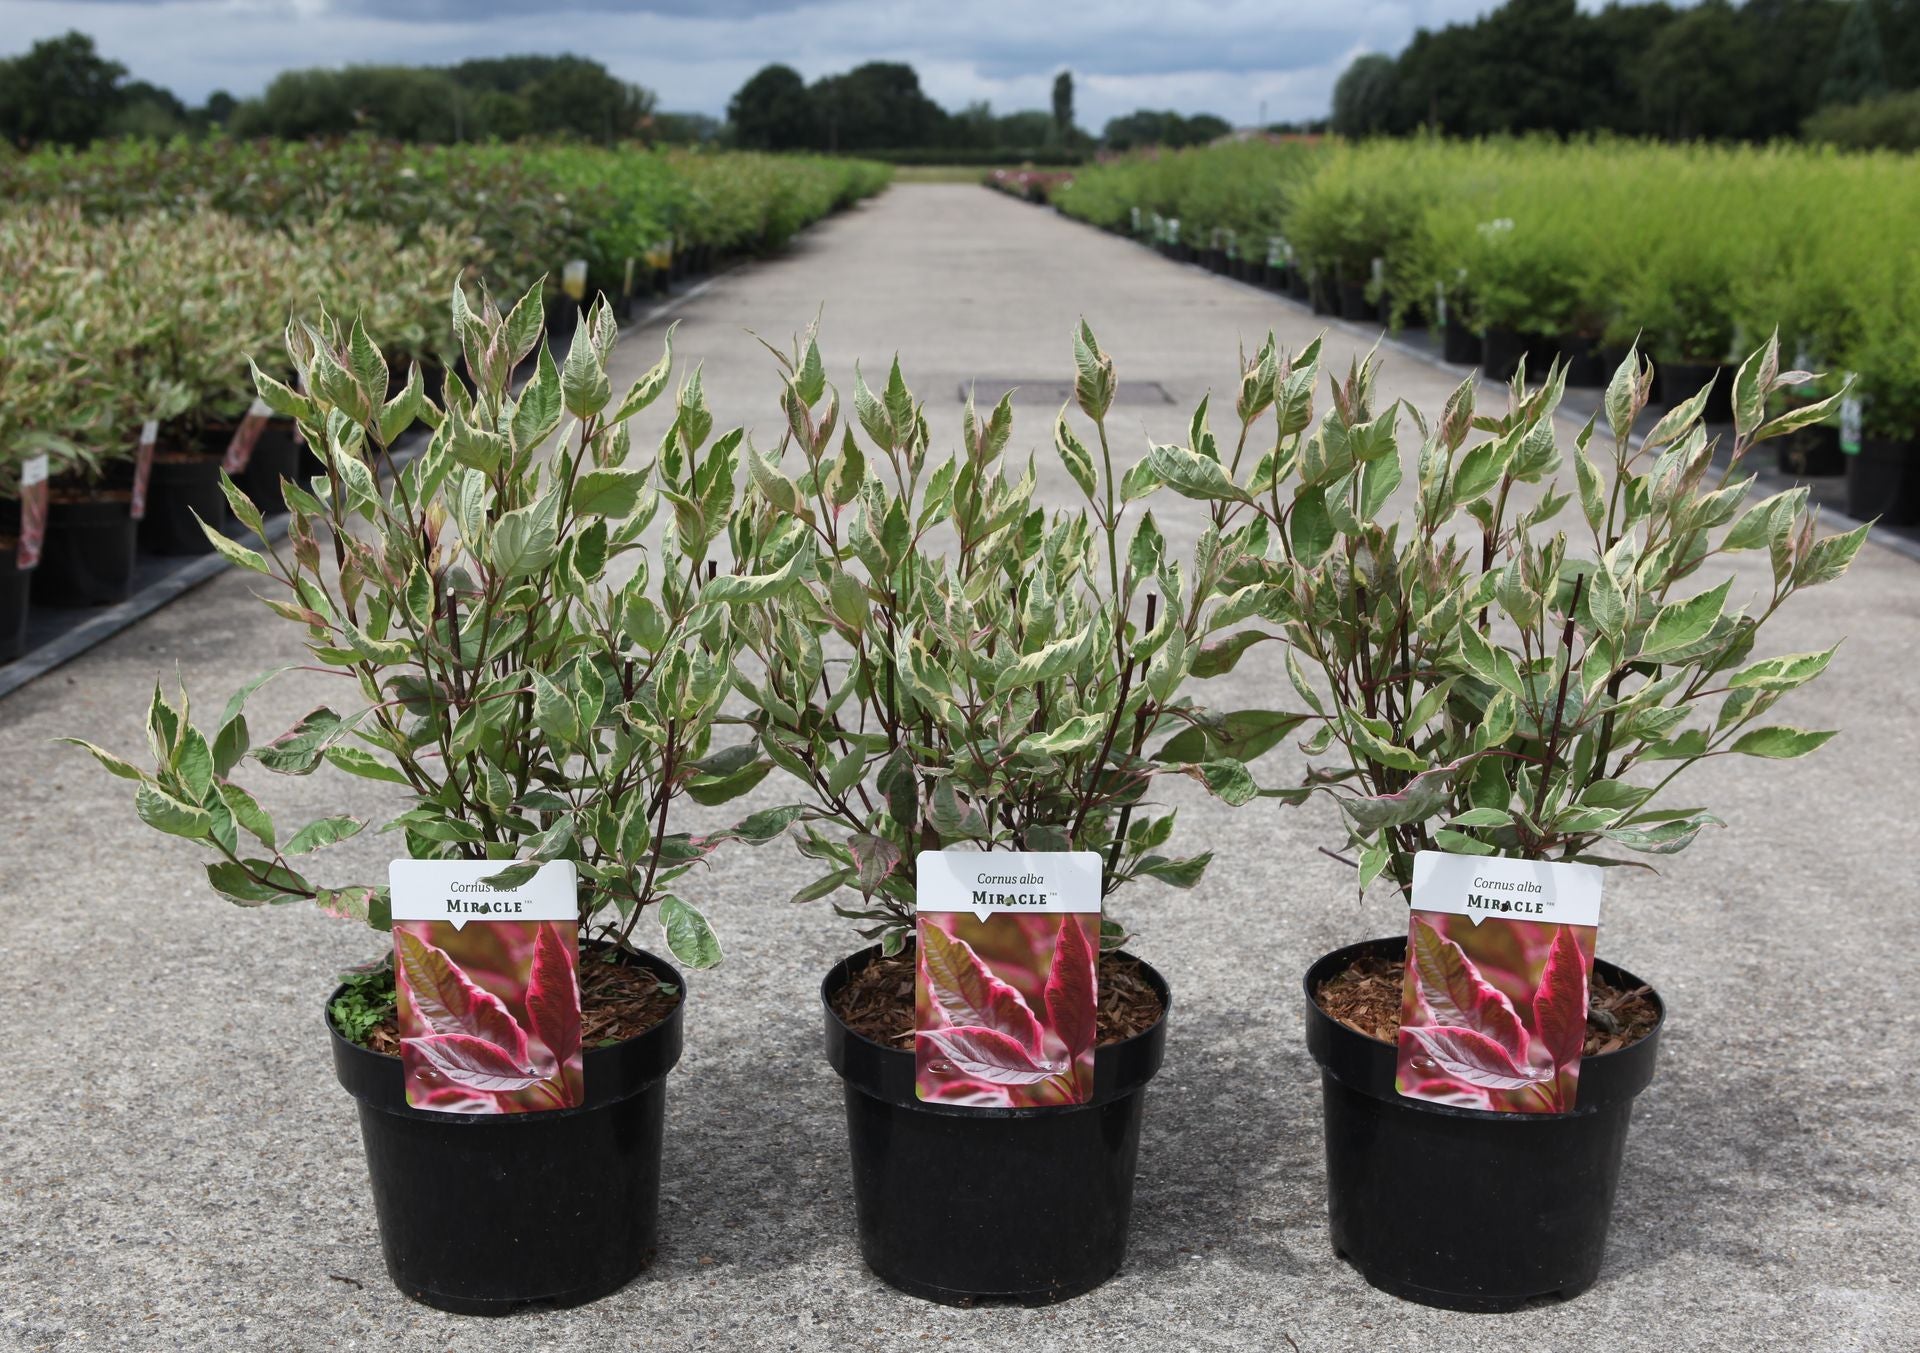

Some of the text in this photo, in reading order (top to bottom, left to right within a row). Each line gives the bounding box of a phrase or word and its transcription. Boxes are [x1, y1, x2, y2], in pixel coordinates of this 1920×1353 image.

[977, 873, 1044, 884] Cornus alba
[1474, 877, 1542, 893] Cornus alba
[450, 881, 490, 893] Cornus
[972, 890, 1047, 905] MIRACLE
[1467, 894, 1543, 914] MIRACLE
[446, 899, 522, 913] MIRACLE
